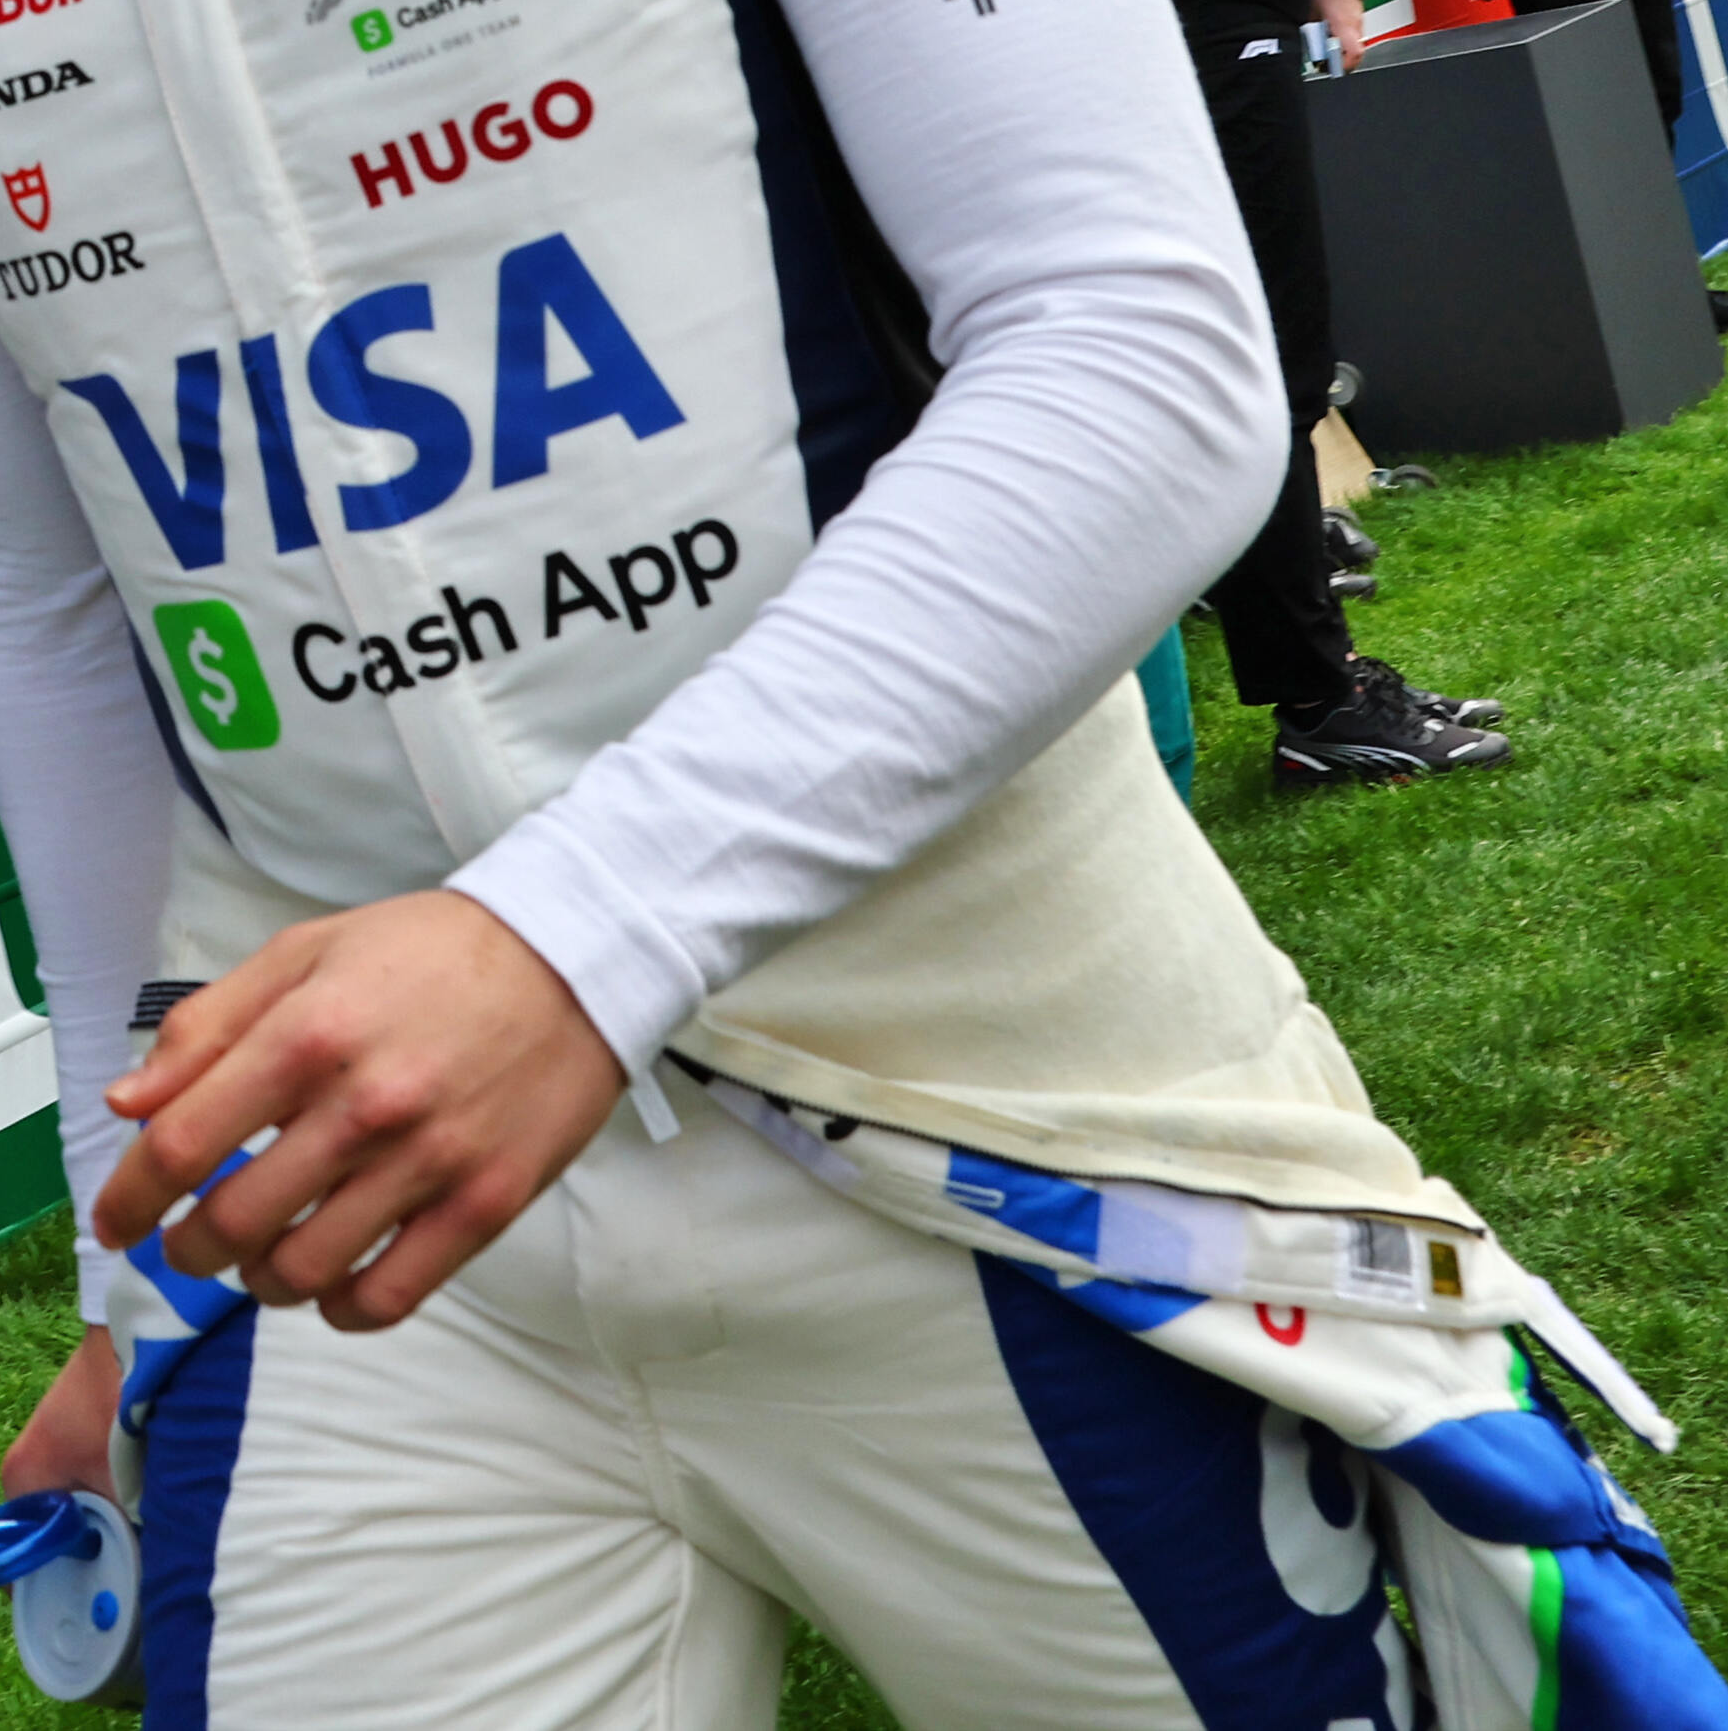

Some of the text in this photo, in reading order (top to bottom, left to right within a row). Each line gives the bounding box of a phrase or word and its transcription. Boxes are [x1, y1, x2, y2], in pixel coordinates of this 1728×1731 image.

[349, 79, 594, 209] HUGO
[58, 232, 686, 572] VISA
[291, 584, 519, 706] Cash
[541, 517, 739, 640] App
